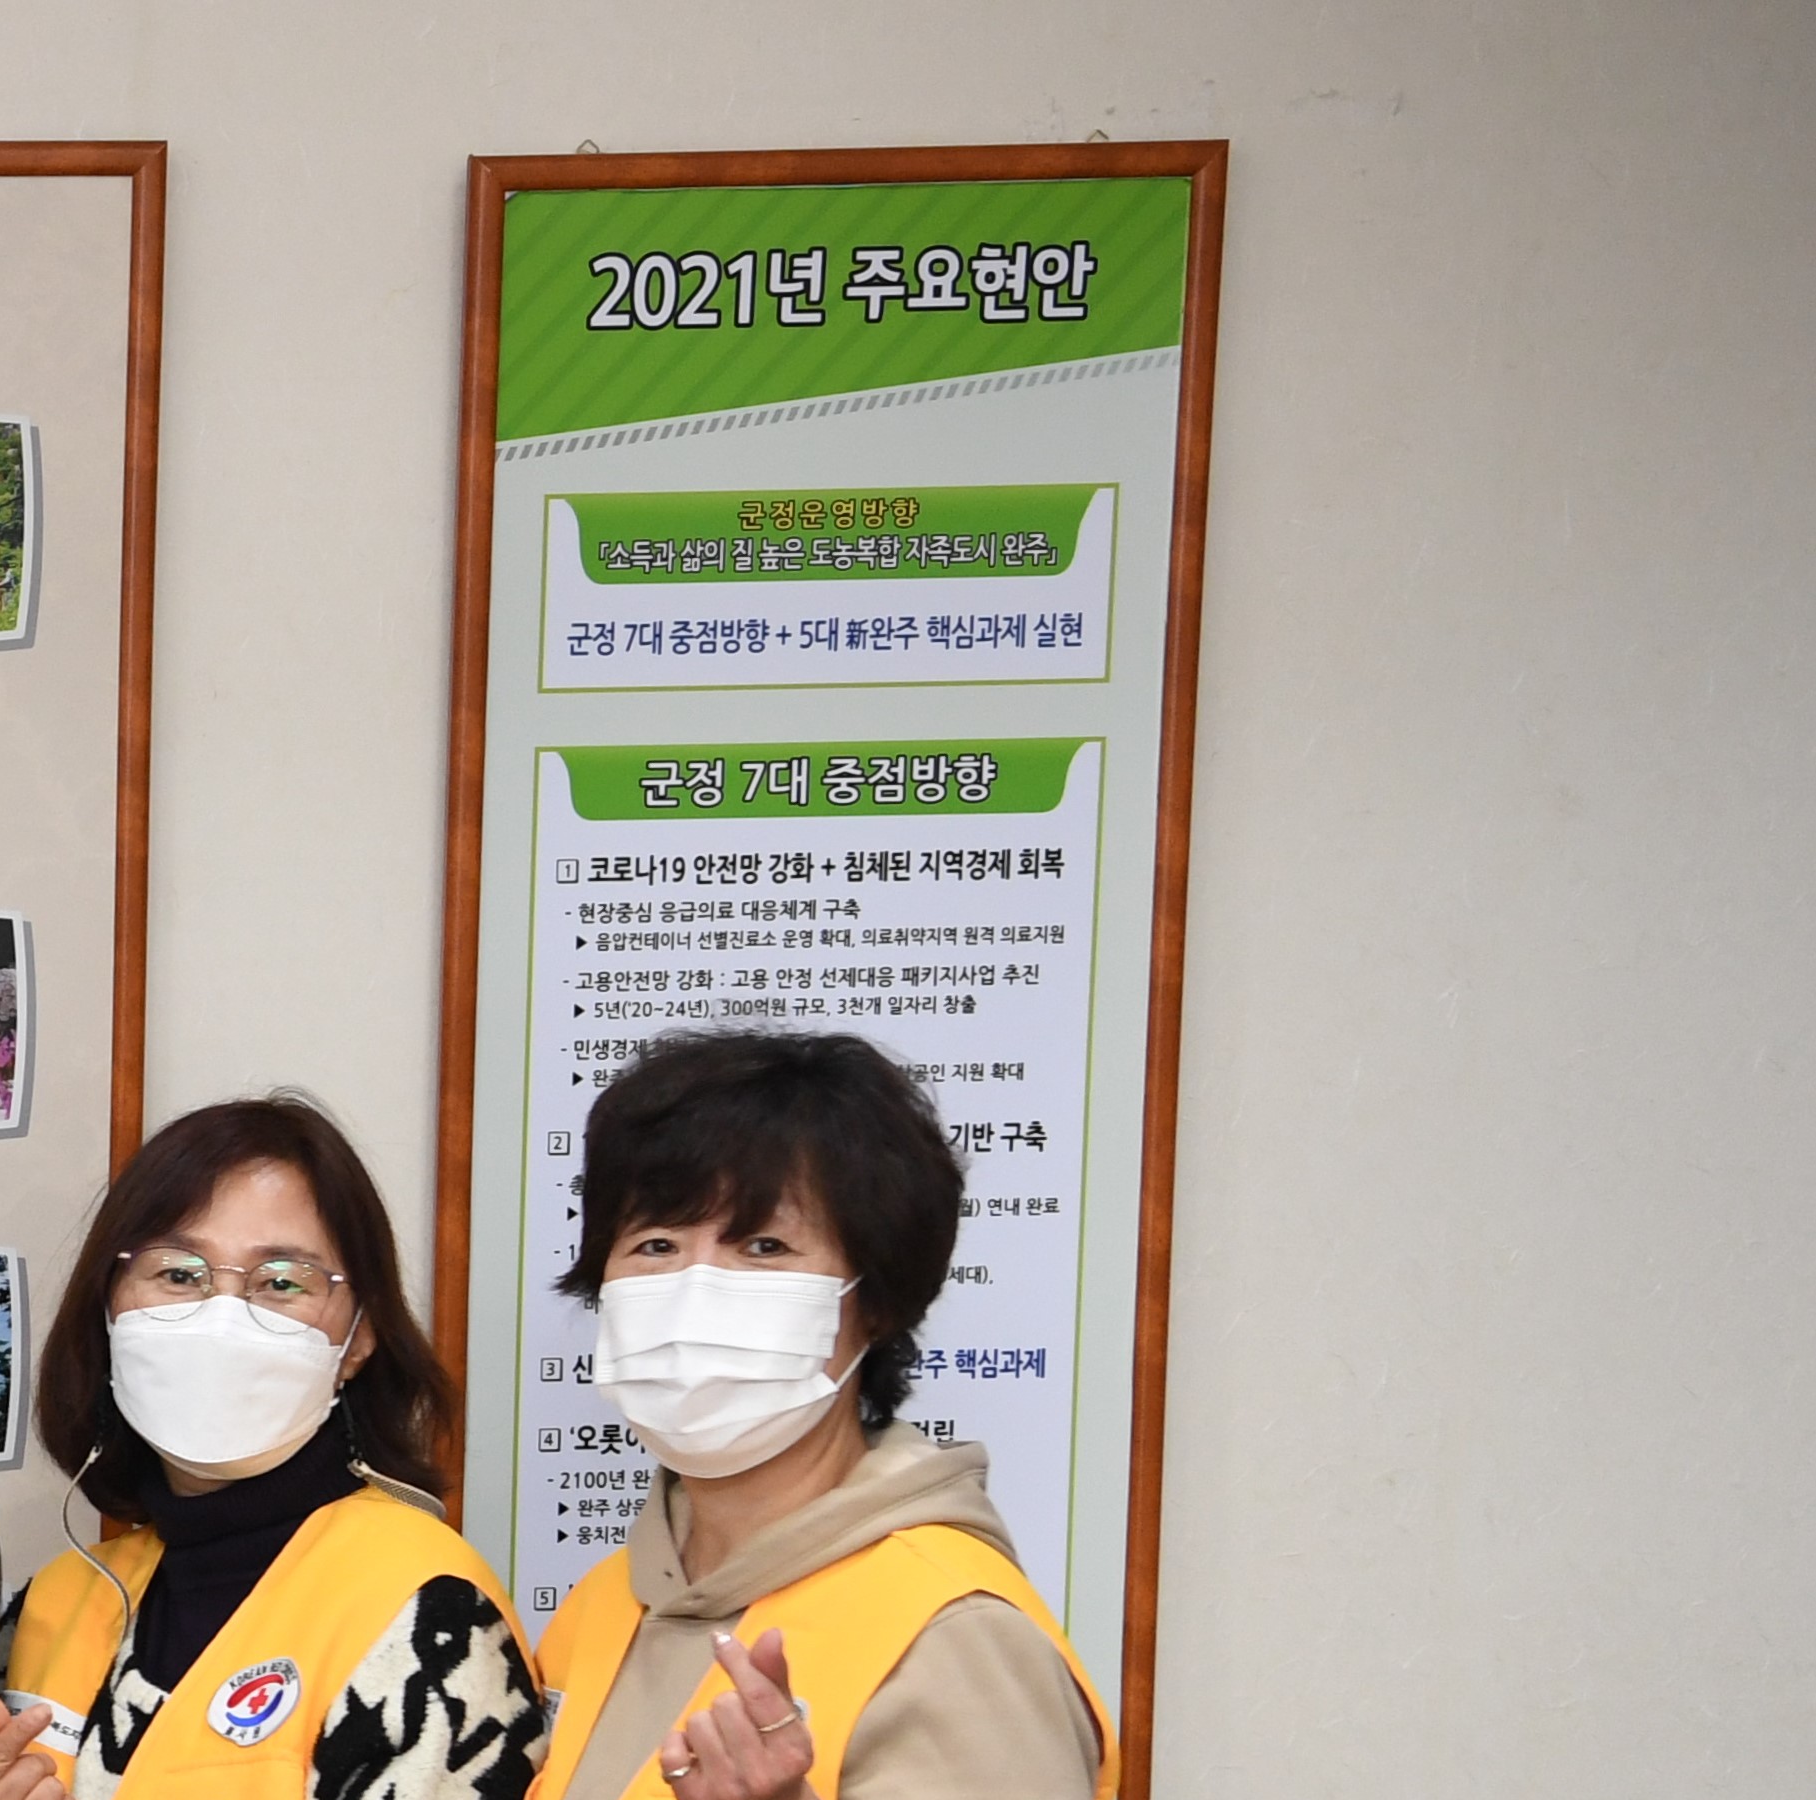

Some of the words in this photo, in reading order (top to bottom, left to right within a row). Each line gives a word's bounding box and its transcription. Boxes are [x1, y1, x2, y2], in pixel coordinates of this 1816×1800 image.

[588, 250, 826, 329] 2021년
[845, 241, 1096, 322] 주요현안
[738, 499, 920, 531] 군정운영방향
[681, 540, 723, 571] 삶의
[731, 539, 753, 570] 질
[760, 538, 804, 569] 높은
[812, 536, 900, 569] 도농복합
[906, 534, 997, 567] 자족도시
[566, 621, 616, 657] 군정
[623, 620, 663, 656] 7대
[668, 618, 771, 655] 중점방향
[799, 616, 839, 652] 5대
[845, 616, 920, 651] 新완주
[926, 613, 1027, 650] 핵심과제
[1033, 612, 1083, 648] 실현
[639, 760, 725, 808] 군정
[742, 758, 809, 805] 7대
[823, 753, 998, 804] 중점방향
[587, 854, 686, 886] 코로나19
[693, 852, 763, 885] 안전망
[768, 852, 815, 885] 강화
[843, 850, 911, 883] 침체된
[918, 848, 1012, 881] 지역경제
[1017, 847, 1065, 880] 회복
[578, 901, 652, 925] 현장중심
[658, 900, 735, 924] 응급의료
[741, 899, 817, 922] 대응체계
[822, 898, 861, 920] 구축
[595, 931, 692, 952] 음압컨테이너
[697, 930, 777, 951] 선별진료소
[781, 929, 814, 949] 운영
[819, 928, 856, 948] 확대,
[861, 926, 958, 947] 의료취약지역
[963, 926, 995, 946] 원격
[999, 924, 1065, 945] 의료지원
[574, 970, 671, 993] 고용안전망
[676, 969, 714, 991] 강화
[730, 968, 770, 990] 고용
[775, 967, 812, 990] 안정
[819, 966, 896, 989] 선제대응
[900, 964, 996, 988] 패키지사업
[1001, 963, 1040, 986] 추진
[720, 997, 786, 1018] 300억원
[791, 997, 831, 1017] 규모,
[836, 996, 882, 1016] 3천개
[887, 995, 937, 1016] 일자리
[943, 994, 977, 1015] 창출
[951, 1062, 985, 1082] 지원
[990, 1062, 1025, 1082] 확대
[949, 1123, 994, 1153] 기반
[999, 1120, 1048, 1153] 구축
[987, 1197, 1021, 1217] 연내
[1025, 1197, 1060, 1216] 완료
[954, 1347, 1046, 1380] 핵심과제
[559, 1470, 625, 1490] 2100년
[577, 1500, 611, 1517] 완주
